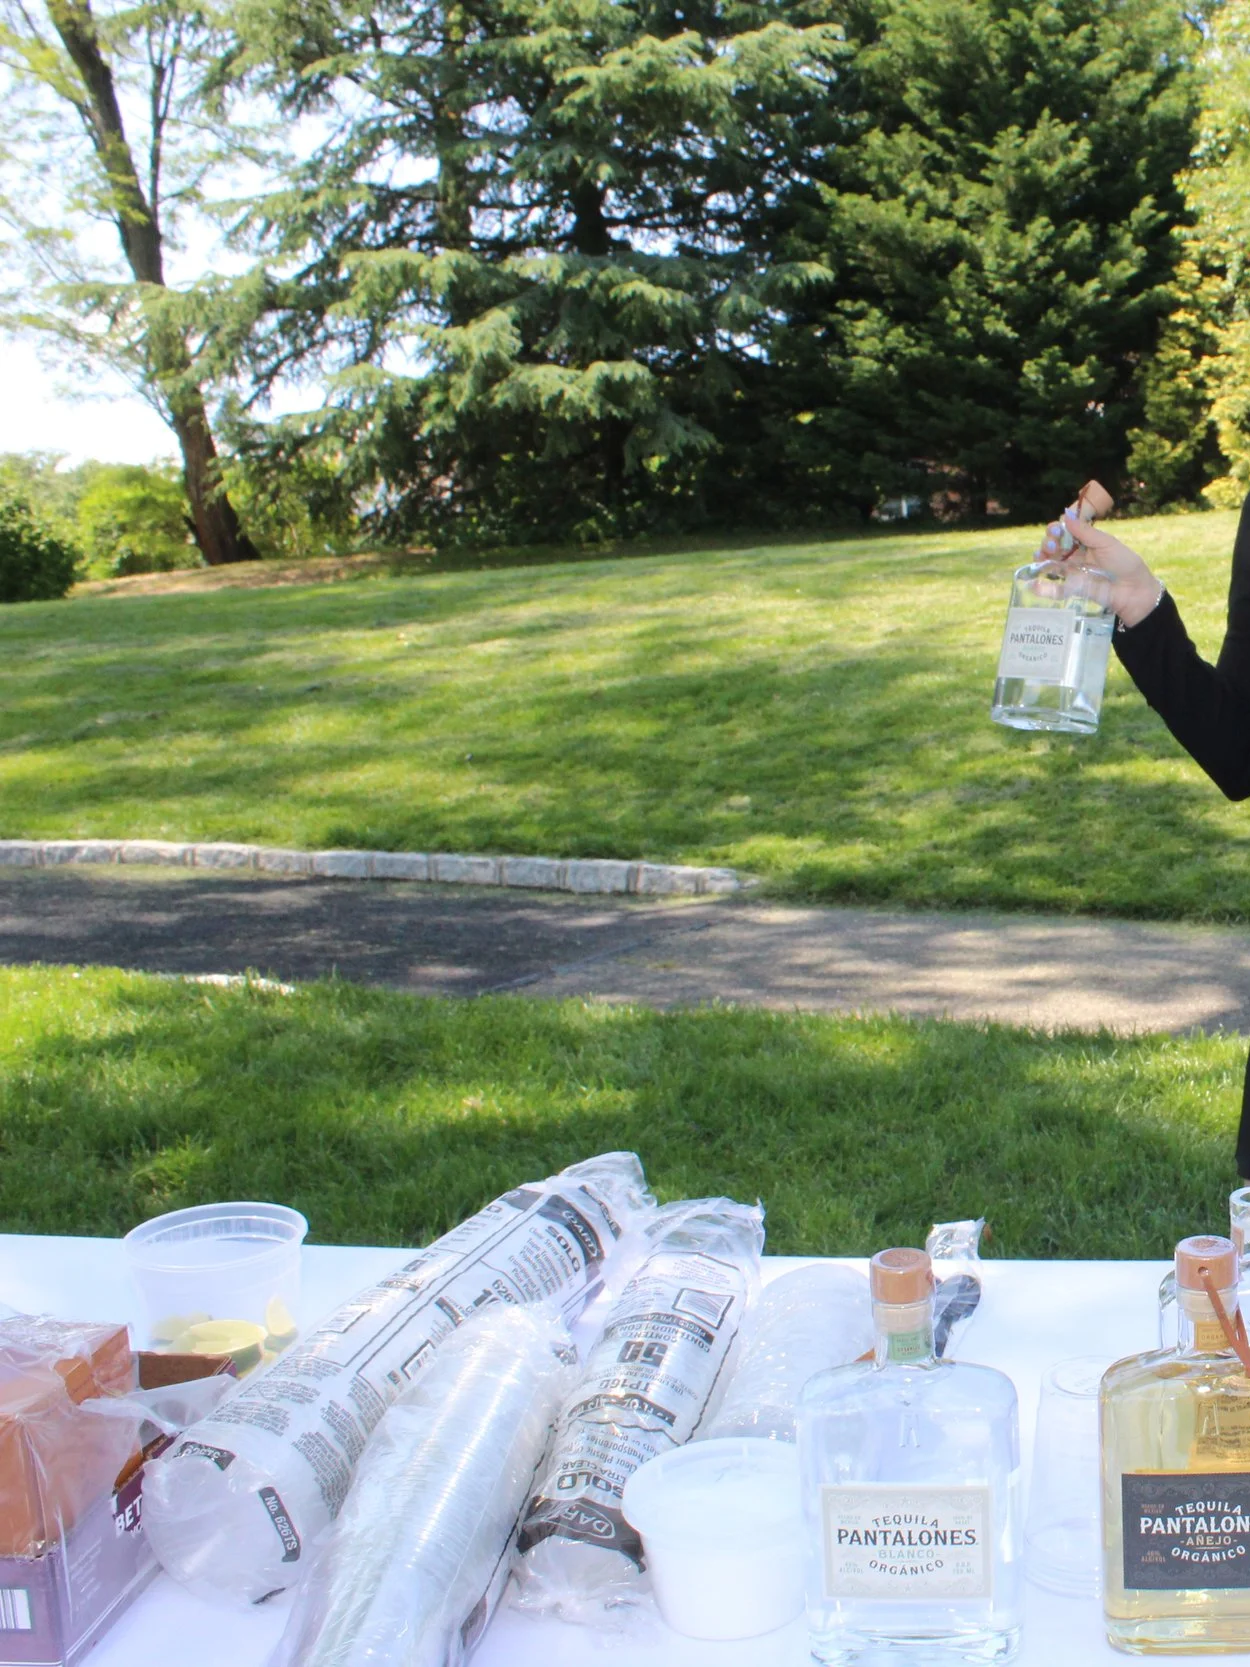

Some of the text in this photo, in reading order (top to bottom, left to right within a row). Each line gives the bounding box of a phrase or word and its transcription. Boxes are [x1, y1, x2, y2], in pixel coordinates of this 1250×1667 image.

[1010, 633, 1064, 645] PANTALONES
[545, 1226, 580, 1272] SOLO
[615, 1339, 668, 1369] 50
[1175, 1501, 1242, 1516] TEQUILA
[265, 1496, 297, 1551] No. 626TS
[561, 1504, 610, 1534] DAR
[872, 1514, 939, 1529] TEQUILA
[837, 1528, 977, 1546] PANTALONES
[878, 1549, 935, 1559] BLANCO
[1171, 1545, 1246, 1563] ORGÁNICO
[869, 1559, 944, 1576] ORGÁNICO
